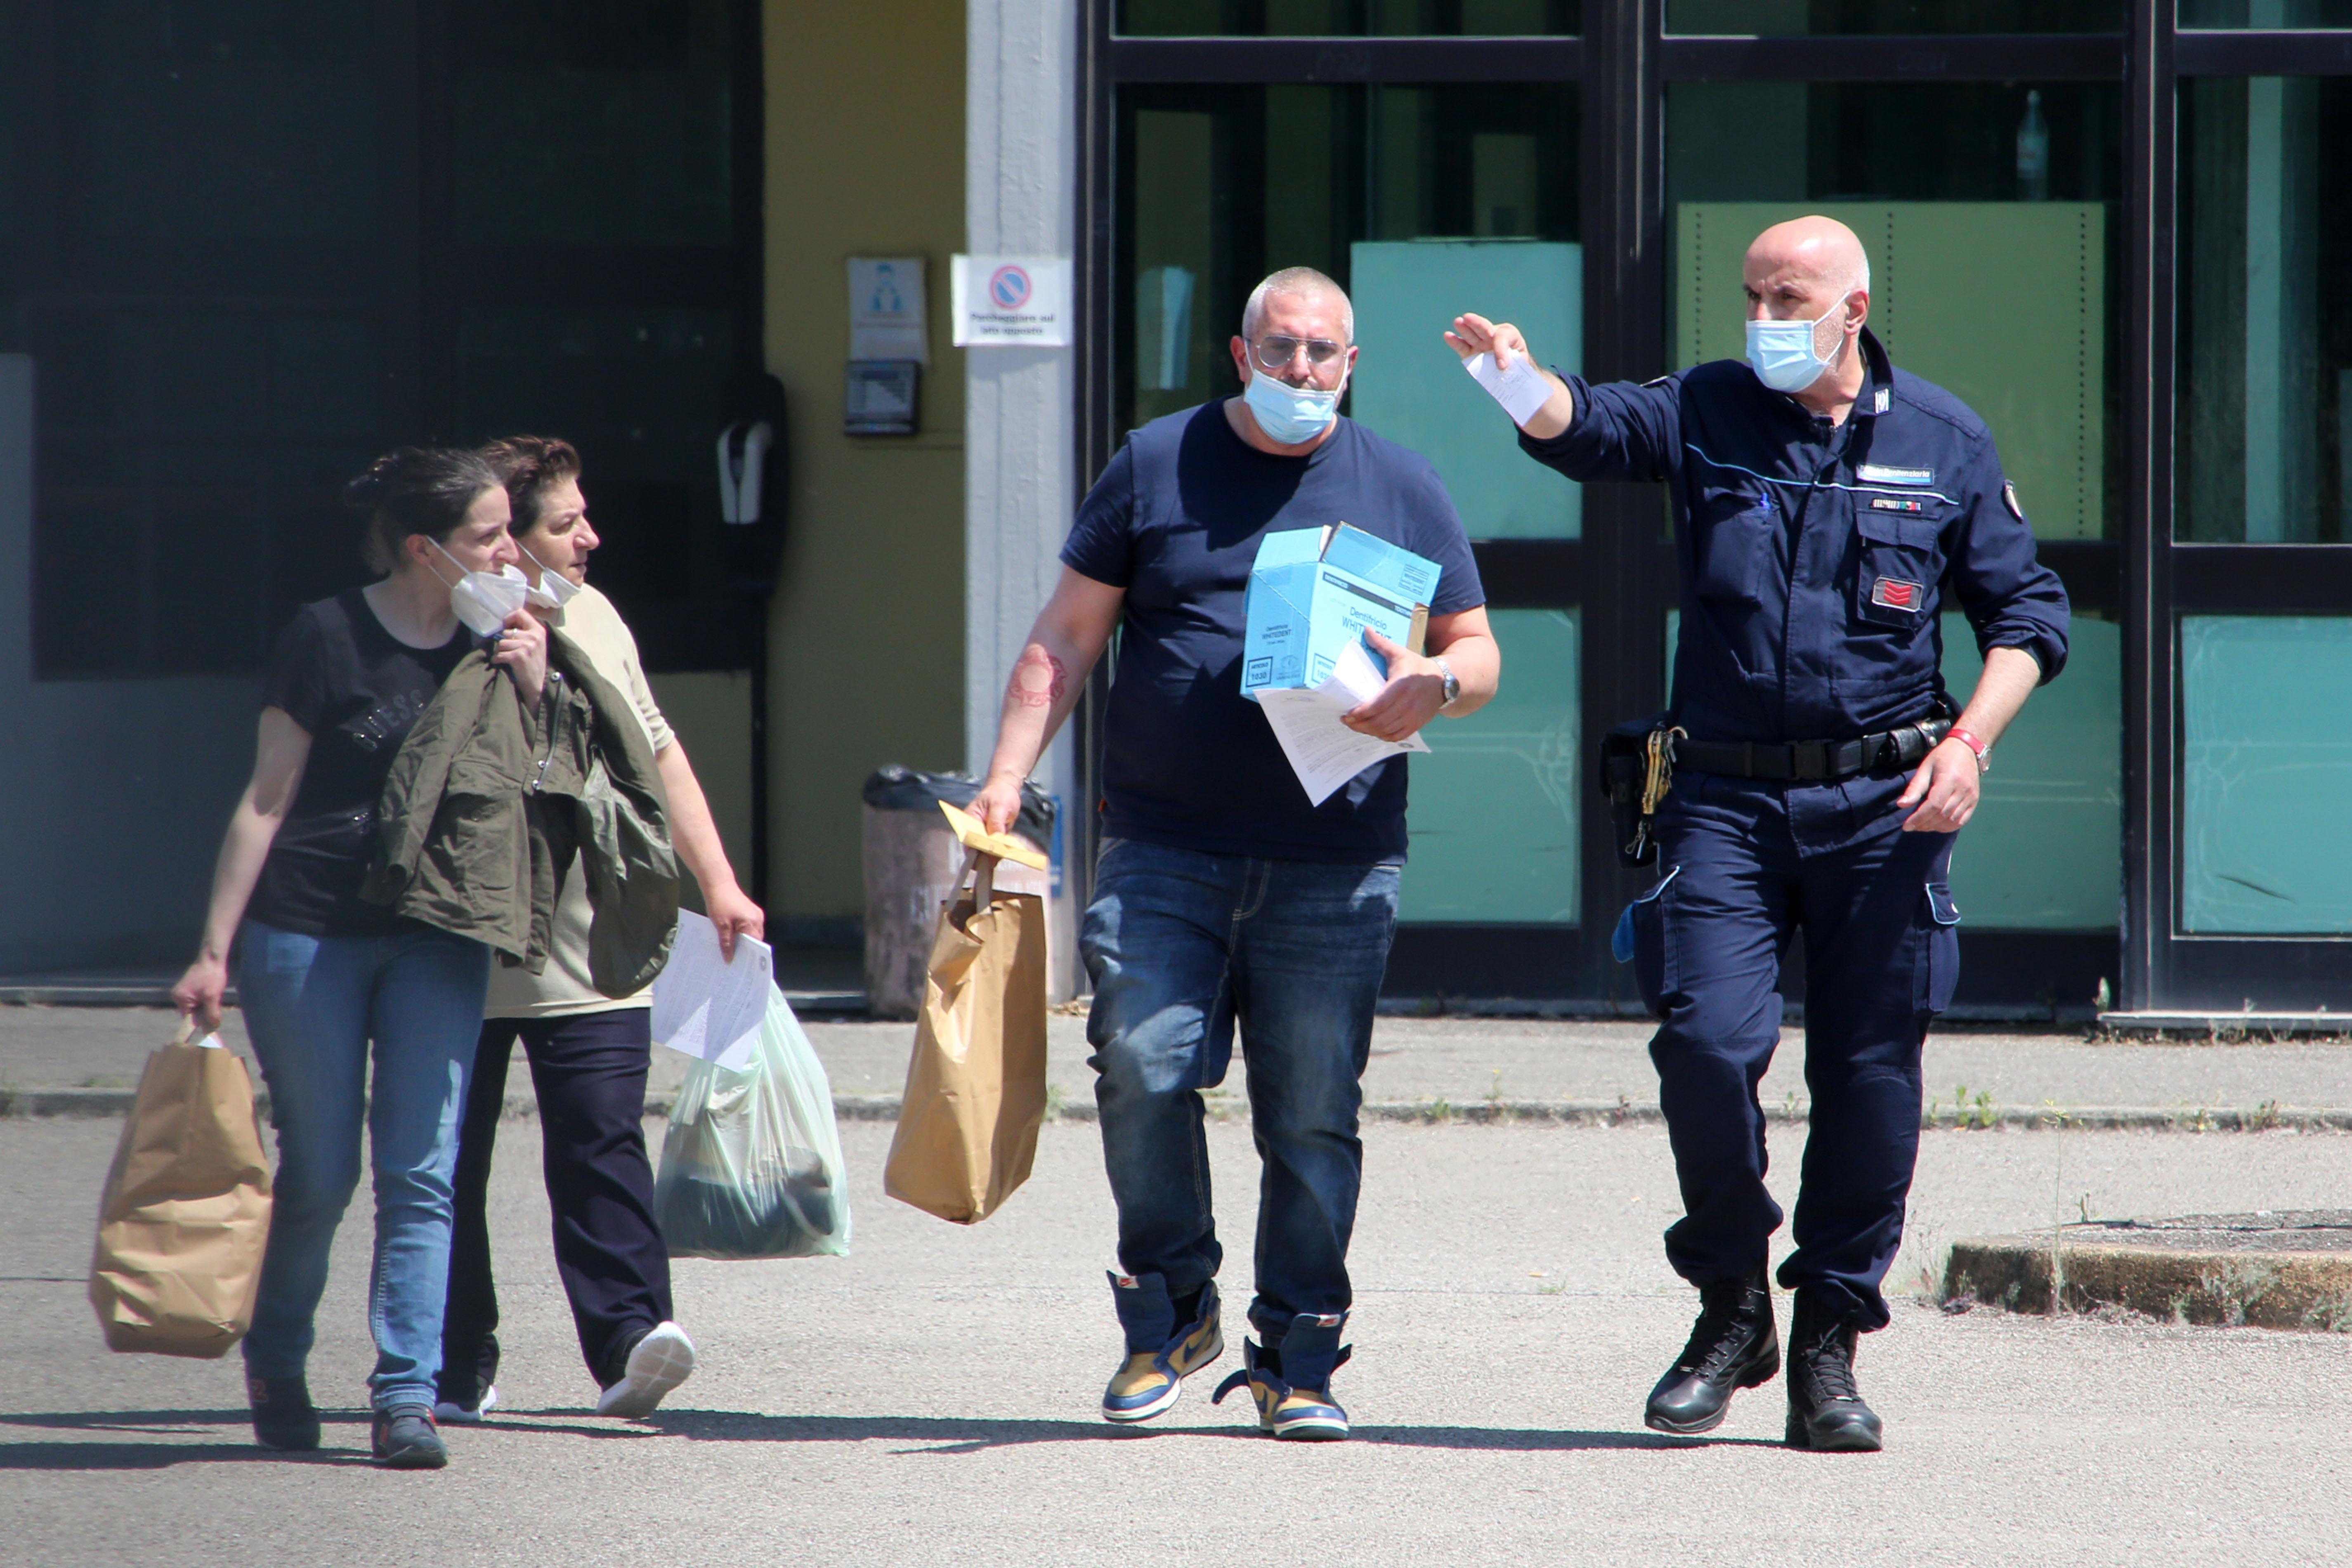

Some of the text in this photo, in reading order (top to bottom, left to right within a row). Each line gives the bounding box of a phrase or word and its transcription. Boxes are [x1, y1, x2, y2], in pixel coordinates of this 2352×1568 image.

[1039, 312, 1054, 322] sul
[1350, 606, 1387, 630] Dentifricio
[1262, 629, 1292, 639] WHITEDENT
[1252, 672, 1267, 680] 1030
